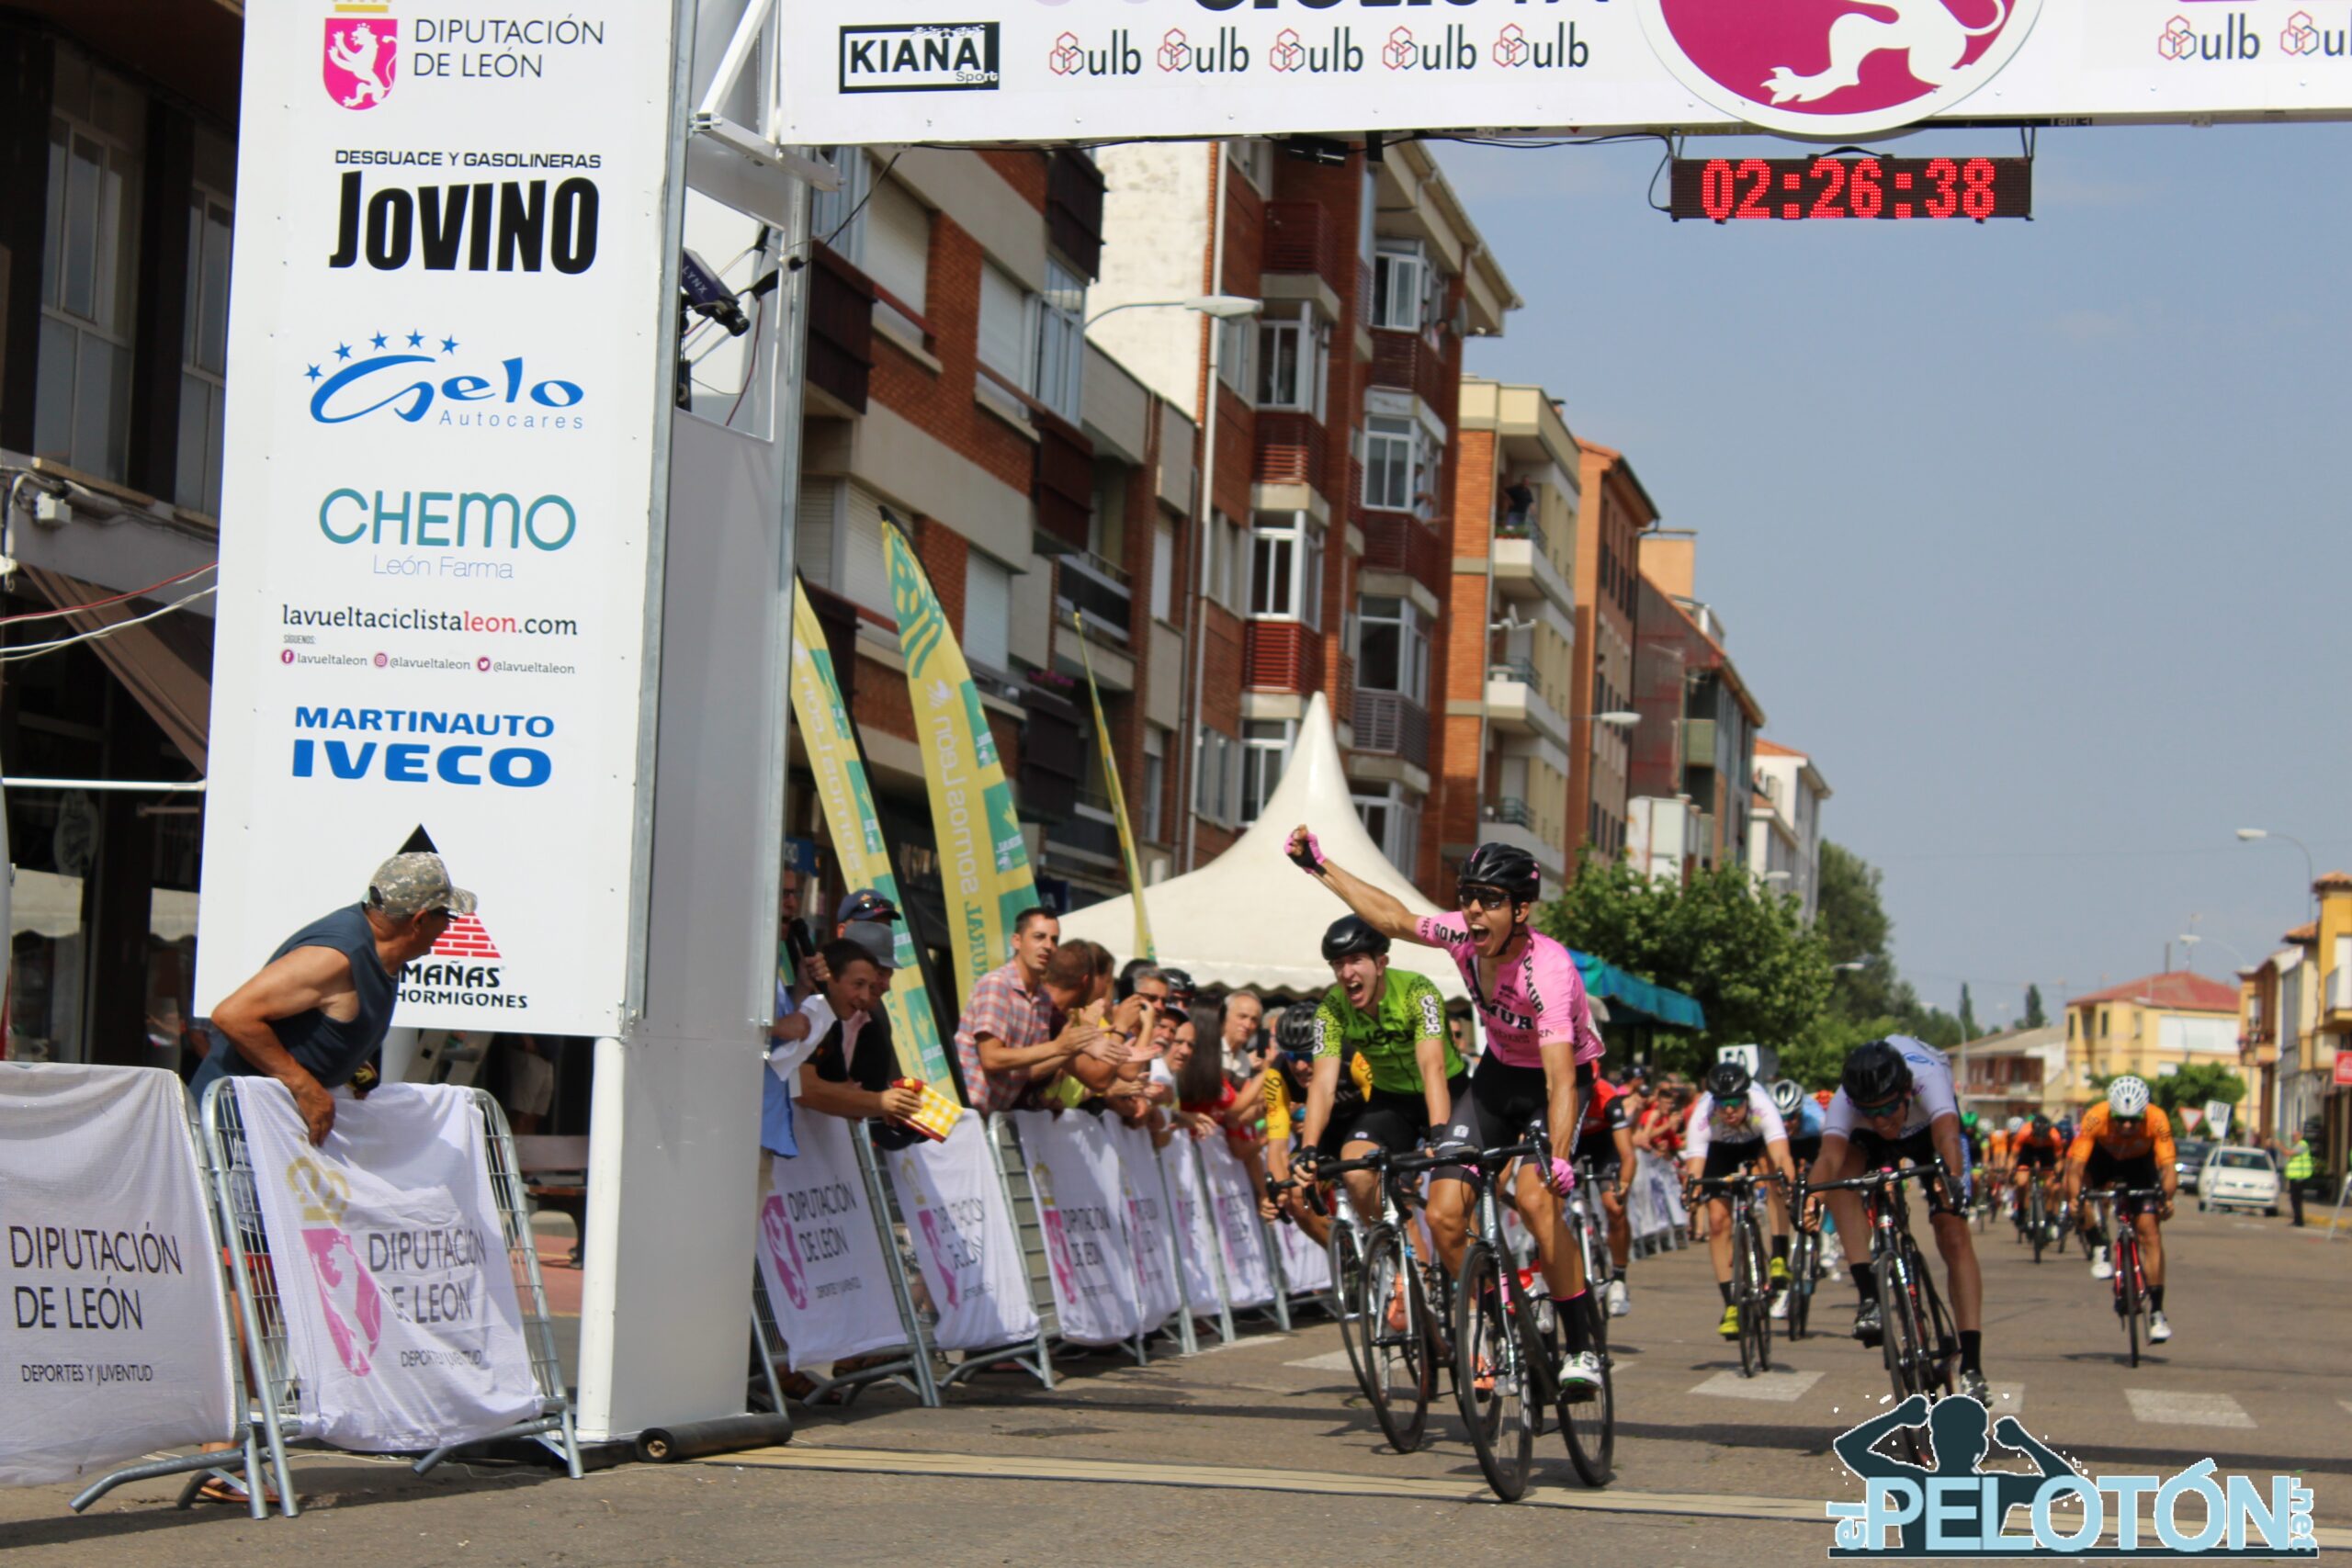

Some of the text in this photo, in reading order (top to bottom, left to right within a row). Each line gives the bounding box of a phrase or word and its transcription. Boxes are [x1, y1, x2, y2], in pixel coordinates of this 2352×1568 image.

[415, 14, 604, 45] DIPUTACIÓN
[1089, 28, 1142, 76] ulb
[1196, 27, 1250, 73] ulb
[1309, 27, 1363, 73] ulb
[1422, 24, 1477, 71] ulb
[1533, 21, 1589, 69] ulb
[2201, 14, 2260, 60] ulb
[413, 47, 542, 78] DE LEÓN
[850, 38, 981, 73] KIANA
[956, 70, 999, 84] Sport
[335, 150, 602, 169] DESGUACE Y GASOLINERAS
[1702, 158, 1996, 220] 02:26:38
[329, 170, 601, 275] JOVINO
[681, 265, 708, 294] LYNX
[310, 355, 584, 423] Gelo
[439, 410, 583, 430] Autocares
[373, 555, 514, 580] León Farma
[282, 604, 578, 636] lavueltaciclistaleon.com
[297, 653, 575, 675] lavueltaleon @lavueltaleon @lavueltaleon
[295, 706, 555, 739] MARTINAUTO
[292, 739, 552, 788] IVECO
[397, 989, 528, 1010] HORMIGONES
[9, 1222, 183, 1274] DIPUTACIÓN
[368, 1219, 487, 1272] DIPUTACIÓN
[15, 1275, 142, 1330] DE LEÓN
[415, 1271, 472, 1324] LEÓN
[21, 1364, 154, 1386] DEPORTES Y JUVENTUD
